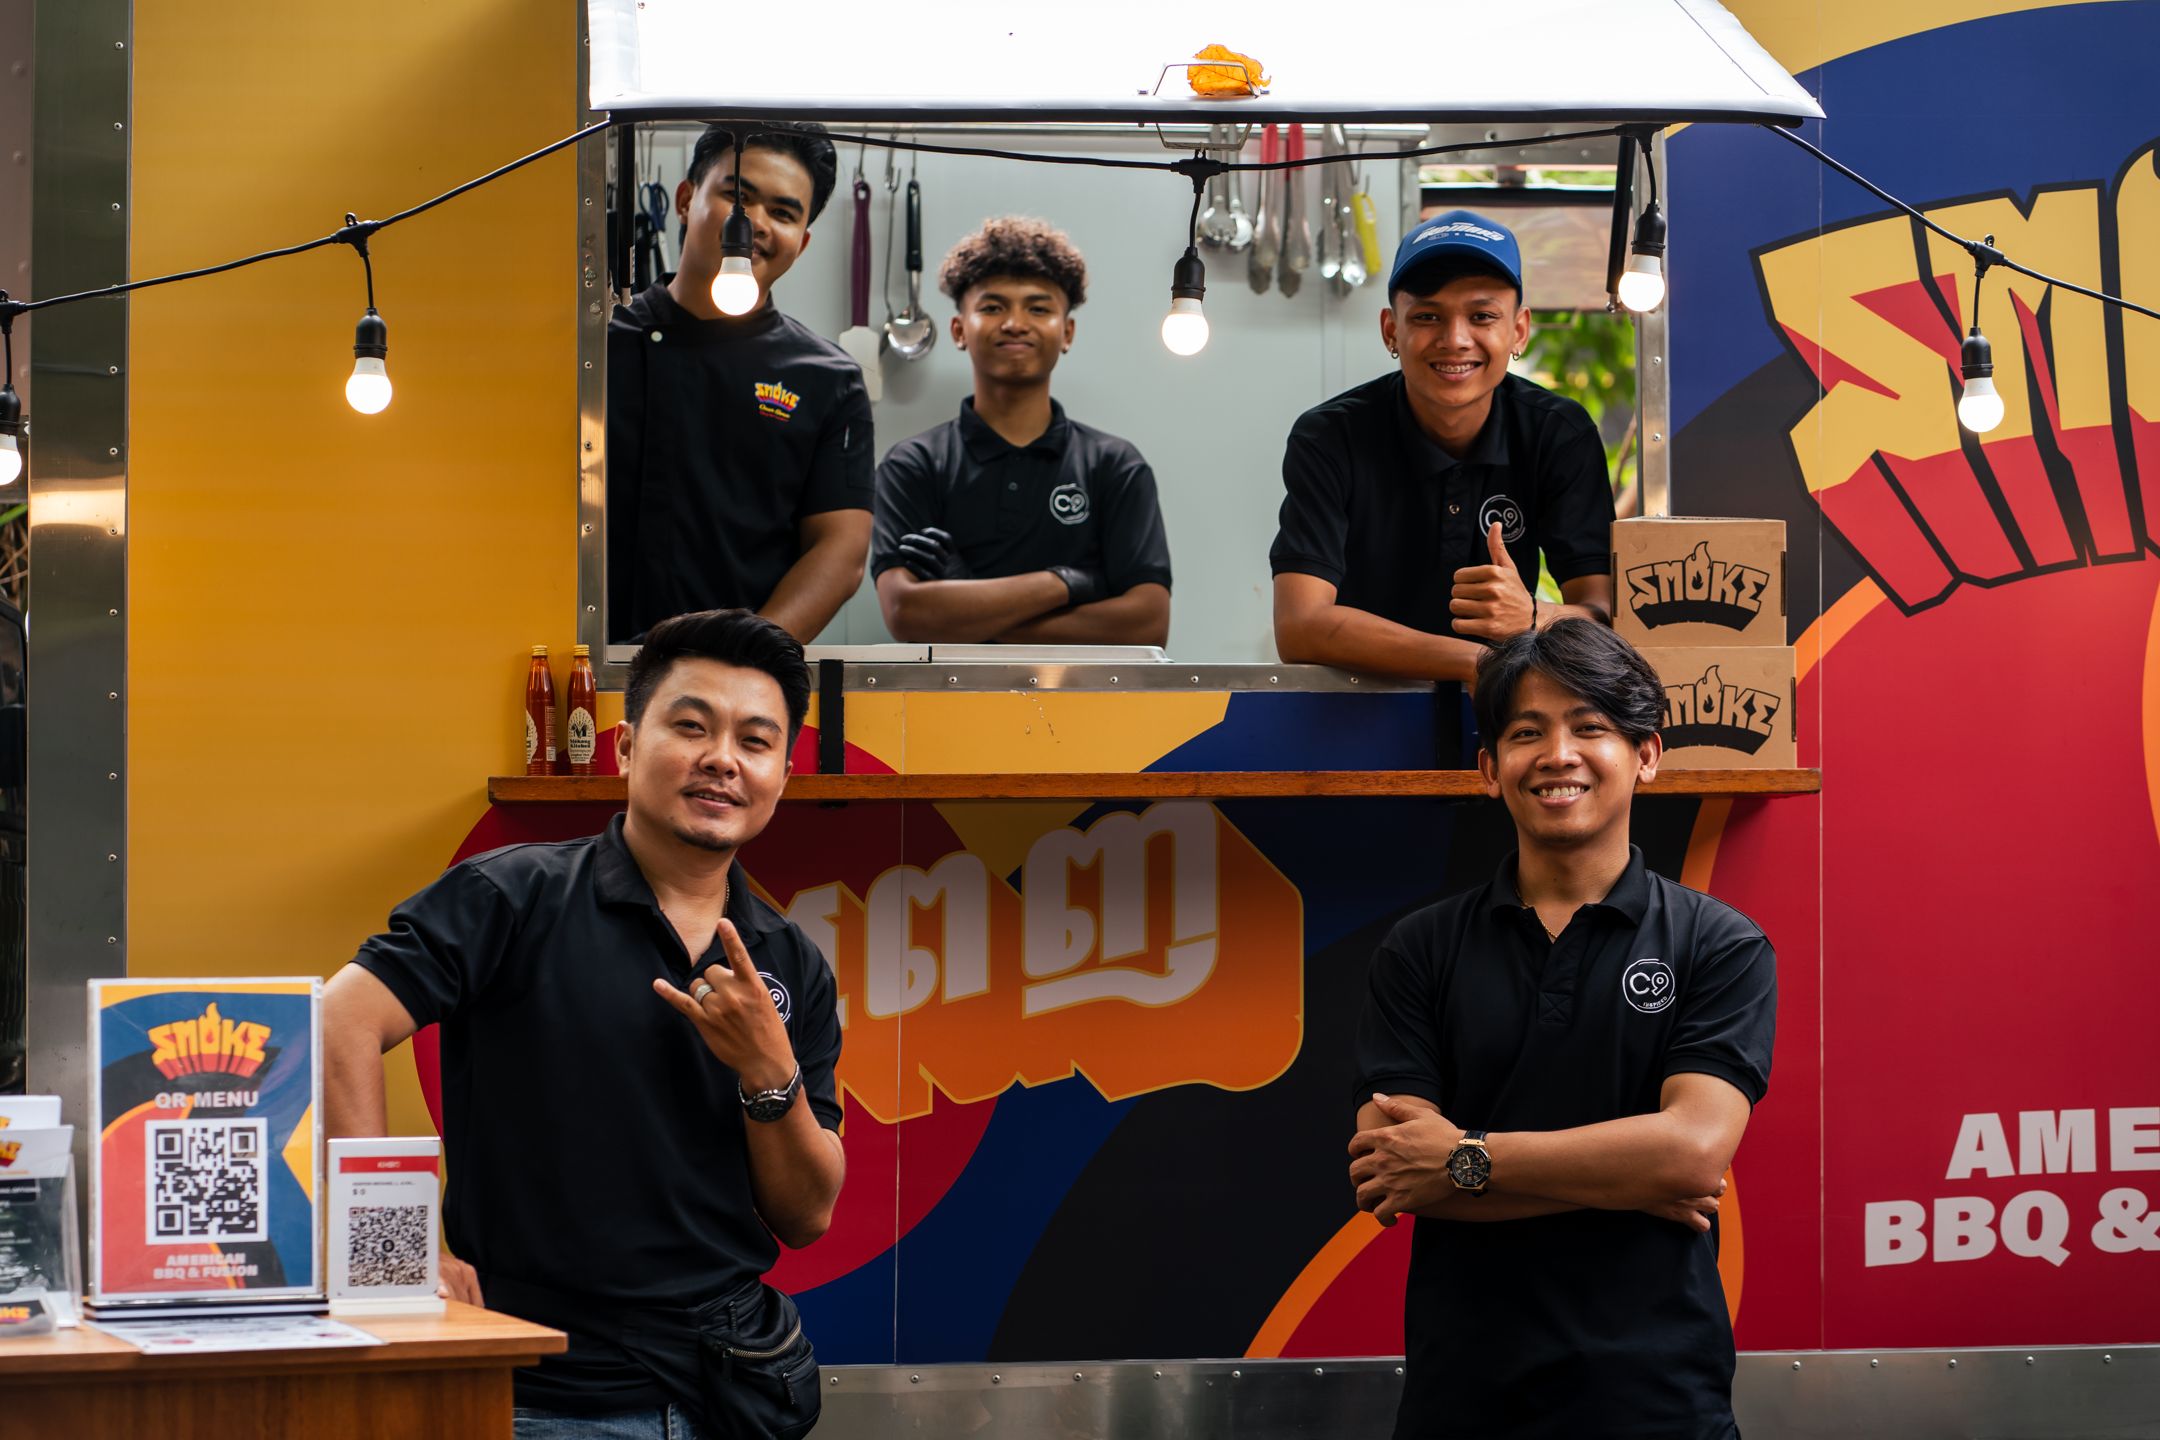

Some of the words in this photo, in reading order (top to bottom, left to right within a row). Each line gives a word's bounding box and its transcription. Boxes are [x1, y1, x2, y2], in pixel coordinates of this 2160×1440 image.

[755, 381, 800, 410] SMOKE
[1626, 541, 1770, 631] SMOKE
[1663, 665, 1781, 756] MOKE
[1630, 972, 1669, 996] C9
[147, 1002, 272, 1080] SMOKE
[154, 1091, 188, 1109] QR
[193, 1090, 259, 1108] MENU
[1945, 1107, 2160, 1180] AME
[1865, 1190, 2071, 1267] BBQ
[153, 1268, 186, 1280] BBQ
[187, 1267, 200, 1279] &
[202, 1265, 259, 1278] FUSION
[166, 1253, 246, 1267] AMERICAN
